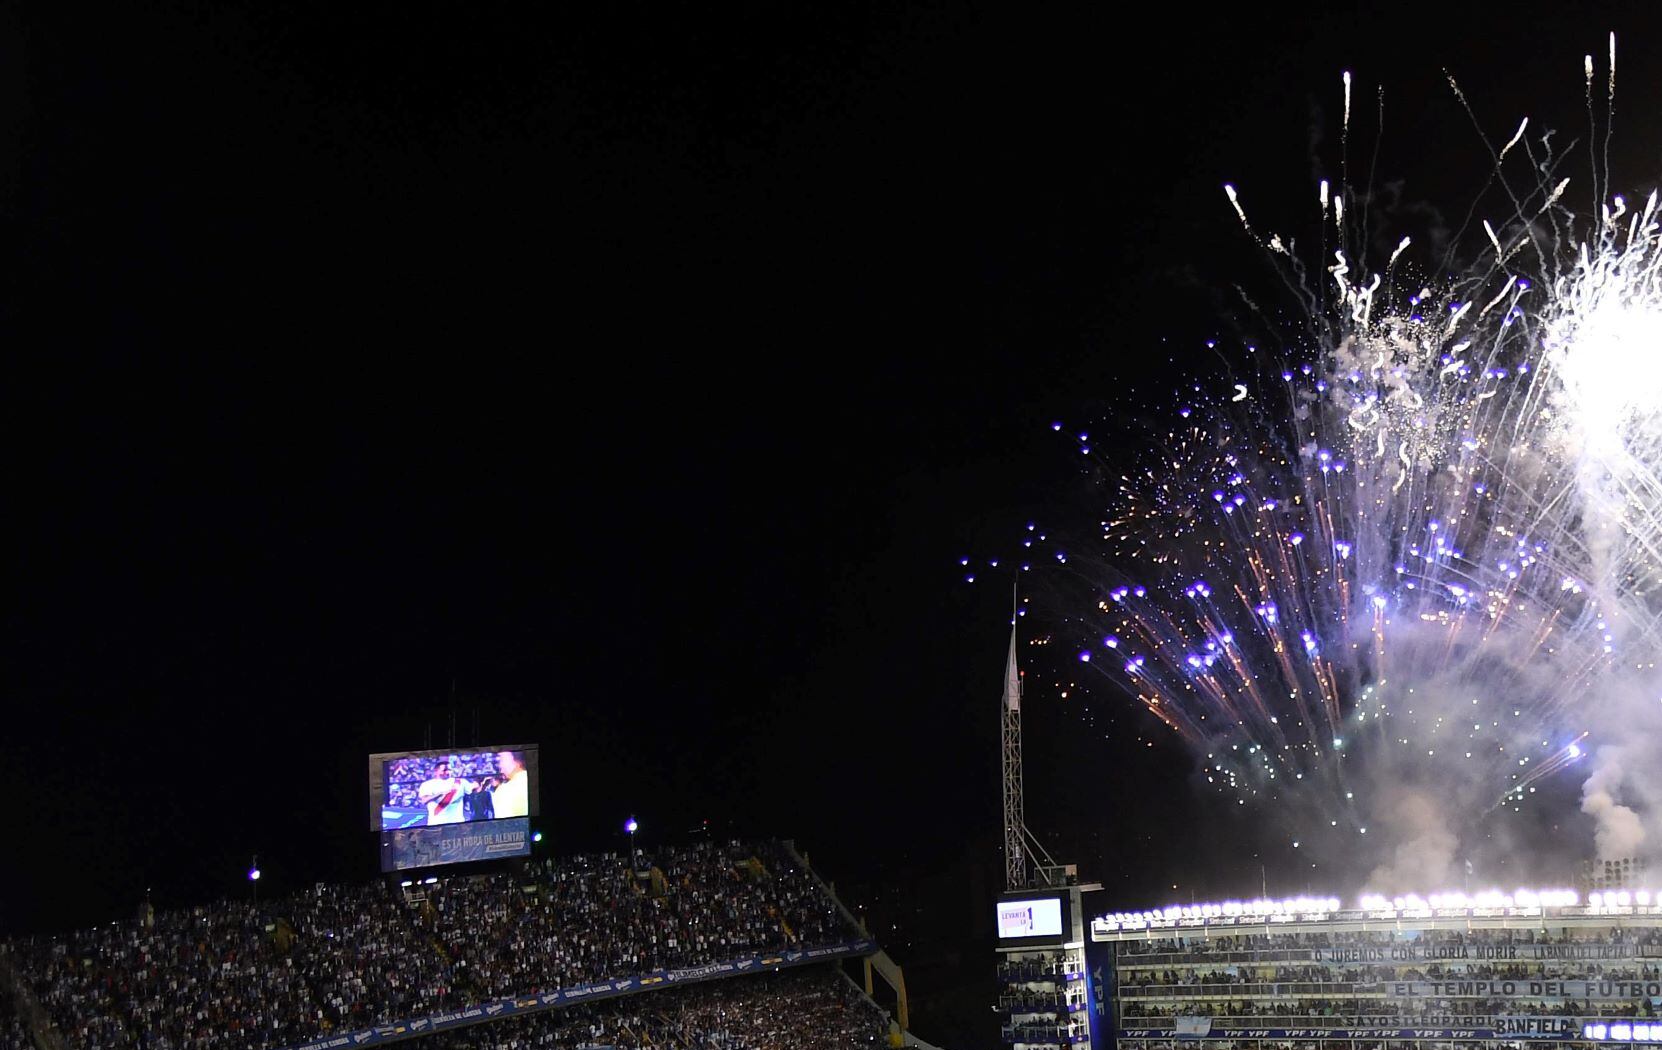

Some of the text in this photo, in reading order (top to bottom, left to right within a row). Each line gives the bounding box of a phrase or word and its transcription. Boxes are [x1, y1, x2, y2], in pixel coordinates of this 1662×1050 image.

[1329, 948, 1384, 962] JUREMOS
[1391, 948, 1417, 961] CON
[1423, 946, 1469, 960] GLORIA
[1476, 946, 1516, 960] MORIR
[1394, 982, 1418, 996] EL
[1431, 982, 1516, 996] TEMPLO
[1530, 982, 1571, 997] DEL
[1496, 1018, 1569, 1034] BANFIELD
[1126, 1030, 1150, 1038] YPF
[1374, 1030, 1400, 1038] YPF
[1414, 1030, 1444, 1038] YPF
